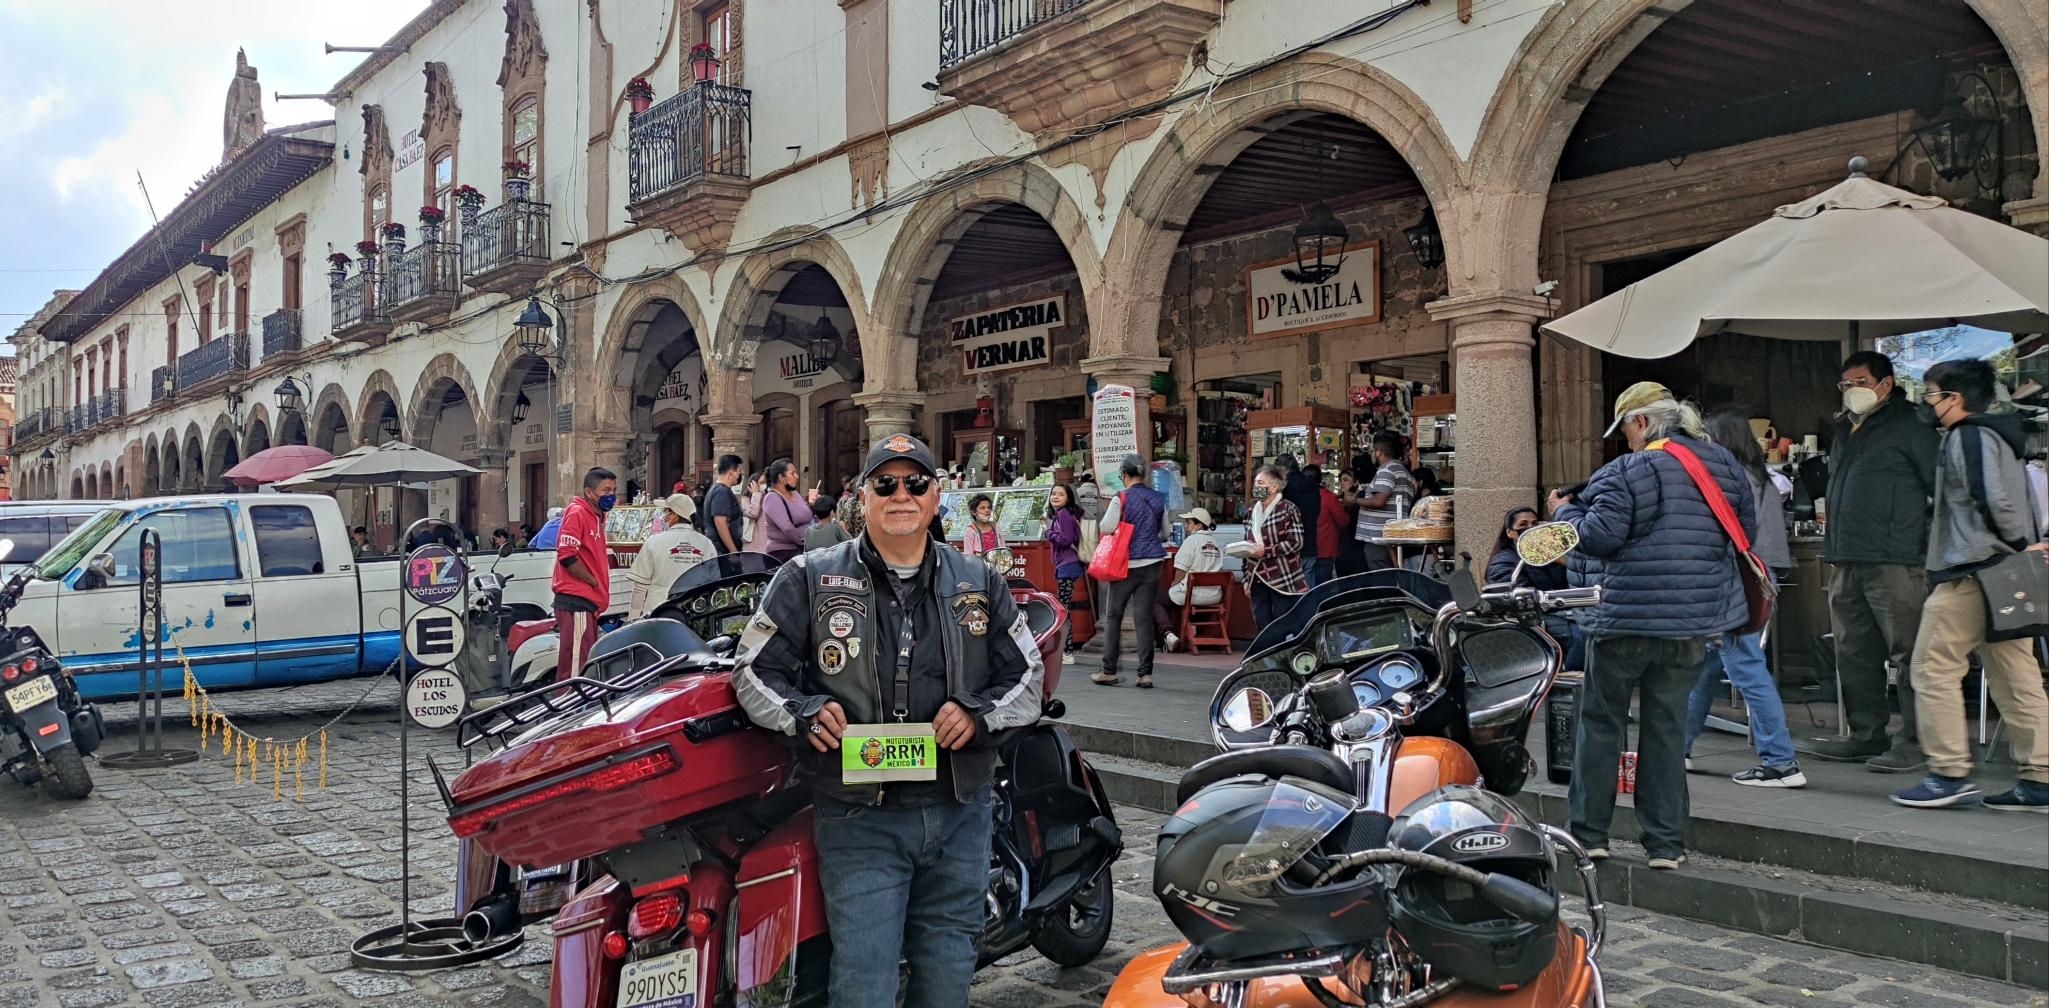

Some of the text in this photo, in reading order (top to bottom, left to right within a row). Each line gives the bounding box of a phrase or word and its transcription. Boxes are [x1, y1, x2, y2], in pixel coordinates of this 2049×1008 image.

[952, 301, 1061, 341] ZAPATERIA
[965, 337, 1047, 370] VERMAR
[780, 352, 826, 377] MALIB
[411, 556, 458, 587] PTZ
[412, 586, 458, 596] Pátzcuaro
[416, 616, 454, 655] E
[416, 677, 454, 689] HOTEL
[423, 690, 447, 701] LOS
[415, 704, 459, 717] ESCUDOS
[886, 737, 925, 745] MOTOTURISTA
[886, 744, 925, 759] RRM
[1460, 836, 1502, 849] HJC
[1162, 882, 1241, 917] HJC
[641, 960, 675, 972] Guanajuato
[626, 968, 687, 1005] 99DYS5
